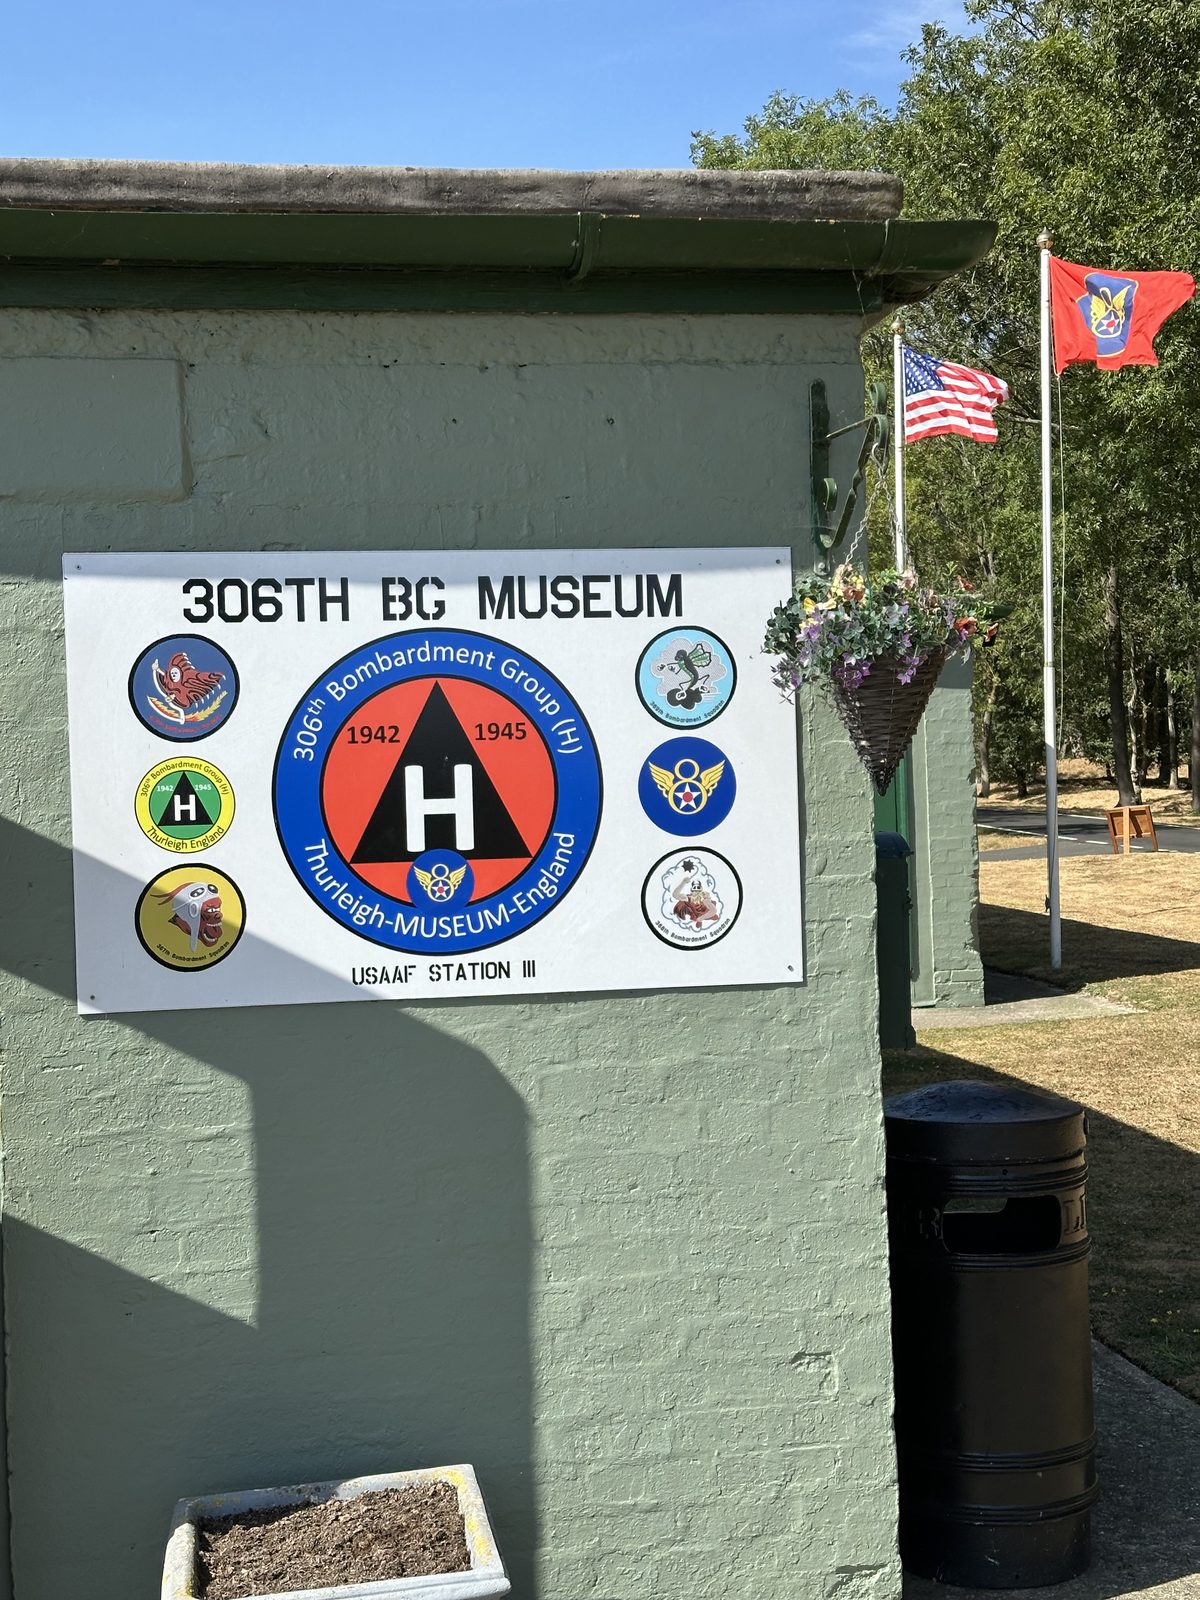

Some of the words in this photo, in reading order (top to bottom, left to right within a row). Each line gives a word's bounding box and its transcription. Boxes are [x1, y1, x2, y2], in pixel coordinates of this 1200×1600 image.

[182, 577, 350, 623] 306TH
[381, 576, 446, 621] BG
[477, 573, 683, 620] MUSEUM
[293, 698, 326, 761] 306th
[326, 641, 496, 701] Bombardment
[501, 658, 560, 715] Group
[551, 718, 583, 754] (H)
[347, 725, 400, 744] 1942
[475, 722, 527, 741] 1945
[150, 761, 202, 780] Bombardment
[203, 765, 224, 783] Group
[156, 784, 174, 792] 1942
[174, 794, 196, 821] H
[405, 763, 475, 852] H
[147, 825, 187, 850] Thurleigh
[190, 825, 225, 849] England
[352, 965, 416, 985] USAAF
[429, 961, 510, 982] STATION
